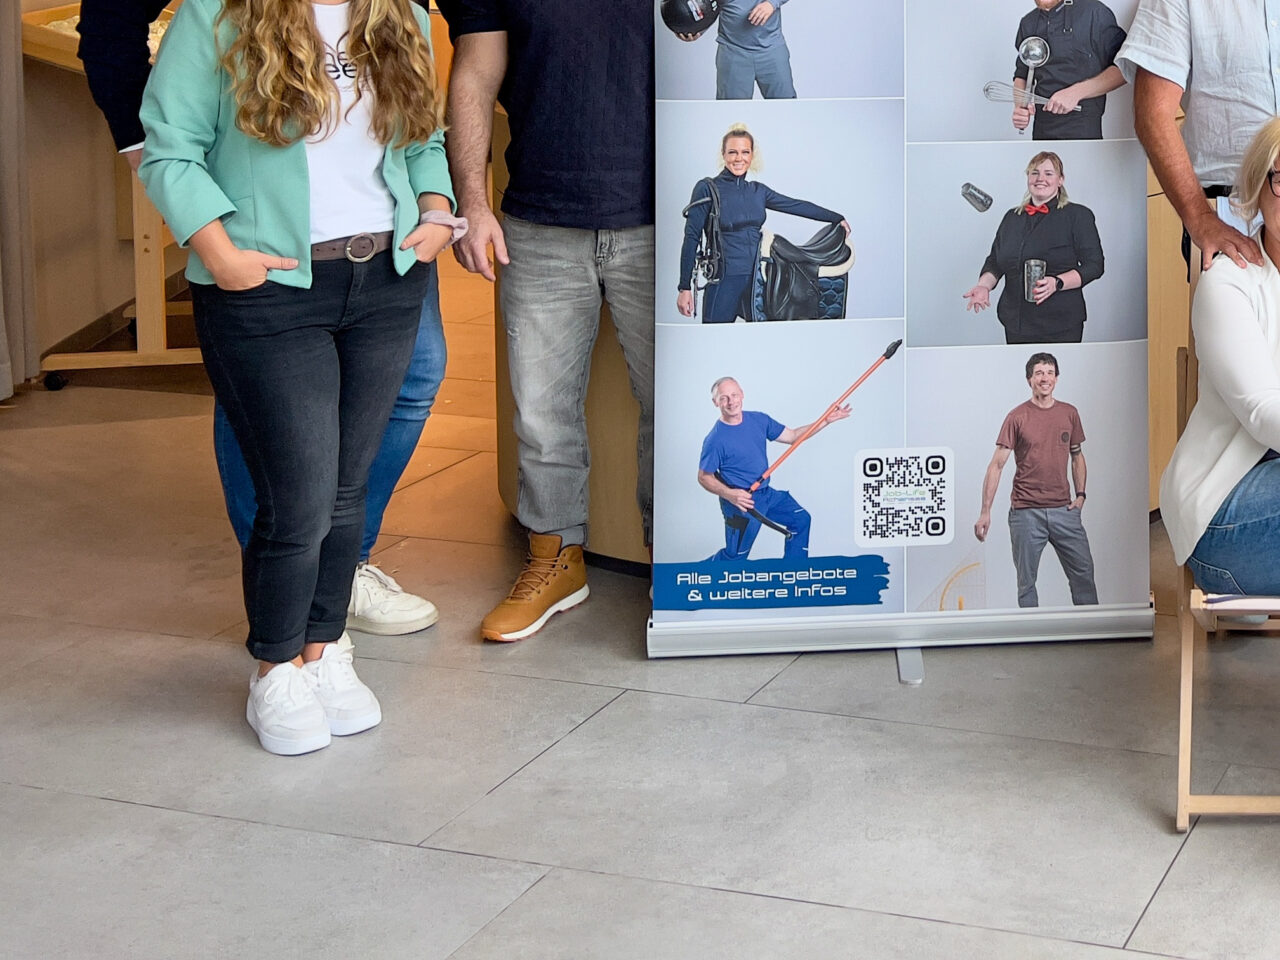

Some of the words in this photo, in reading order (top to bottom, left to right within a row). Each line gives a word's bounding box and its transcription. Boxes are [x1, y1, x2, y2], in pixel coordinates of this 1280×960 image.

[676, 572, 712, 586] Alle
[718, 568, 857, 585] Jobangebote
[687, 589, 703, 602] &
[709, 587, 788, 601] weitere
[794, 583, 847, 597] Infos
